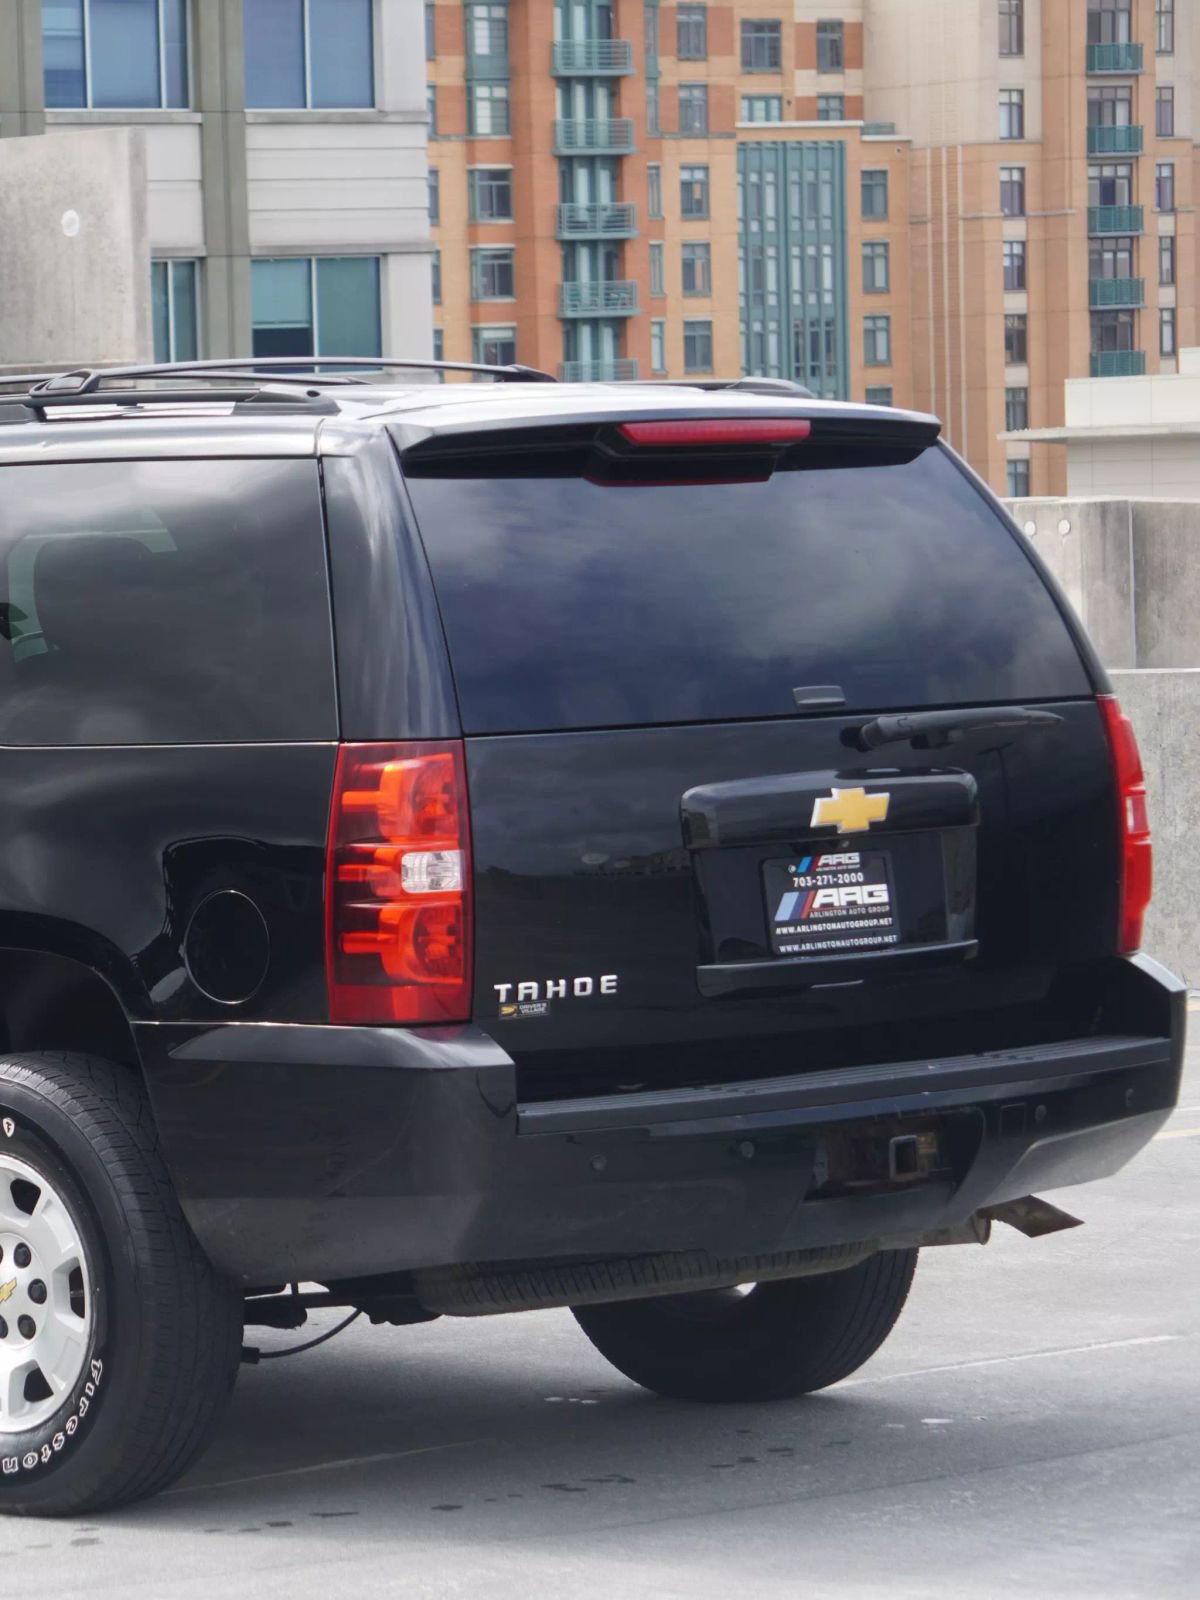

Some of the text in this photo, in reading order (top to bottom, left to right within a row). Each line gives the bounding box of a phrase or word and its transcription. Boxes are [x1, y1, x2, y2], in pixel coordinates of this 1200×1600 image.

[793, 872, 864, 888] 703-271-2000
[812, 883, 889, 909] AAG
[775, 917, 893, 935] WWW.ARLINGTONAUTOGROUP.NET
[779, 935, 897, 953] WWW.ARLINGTONAUTOGROUP.NET
[493, 974, 618, 1003] TAHOE
